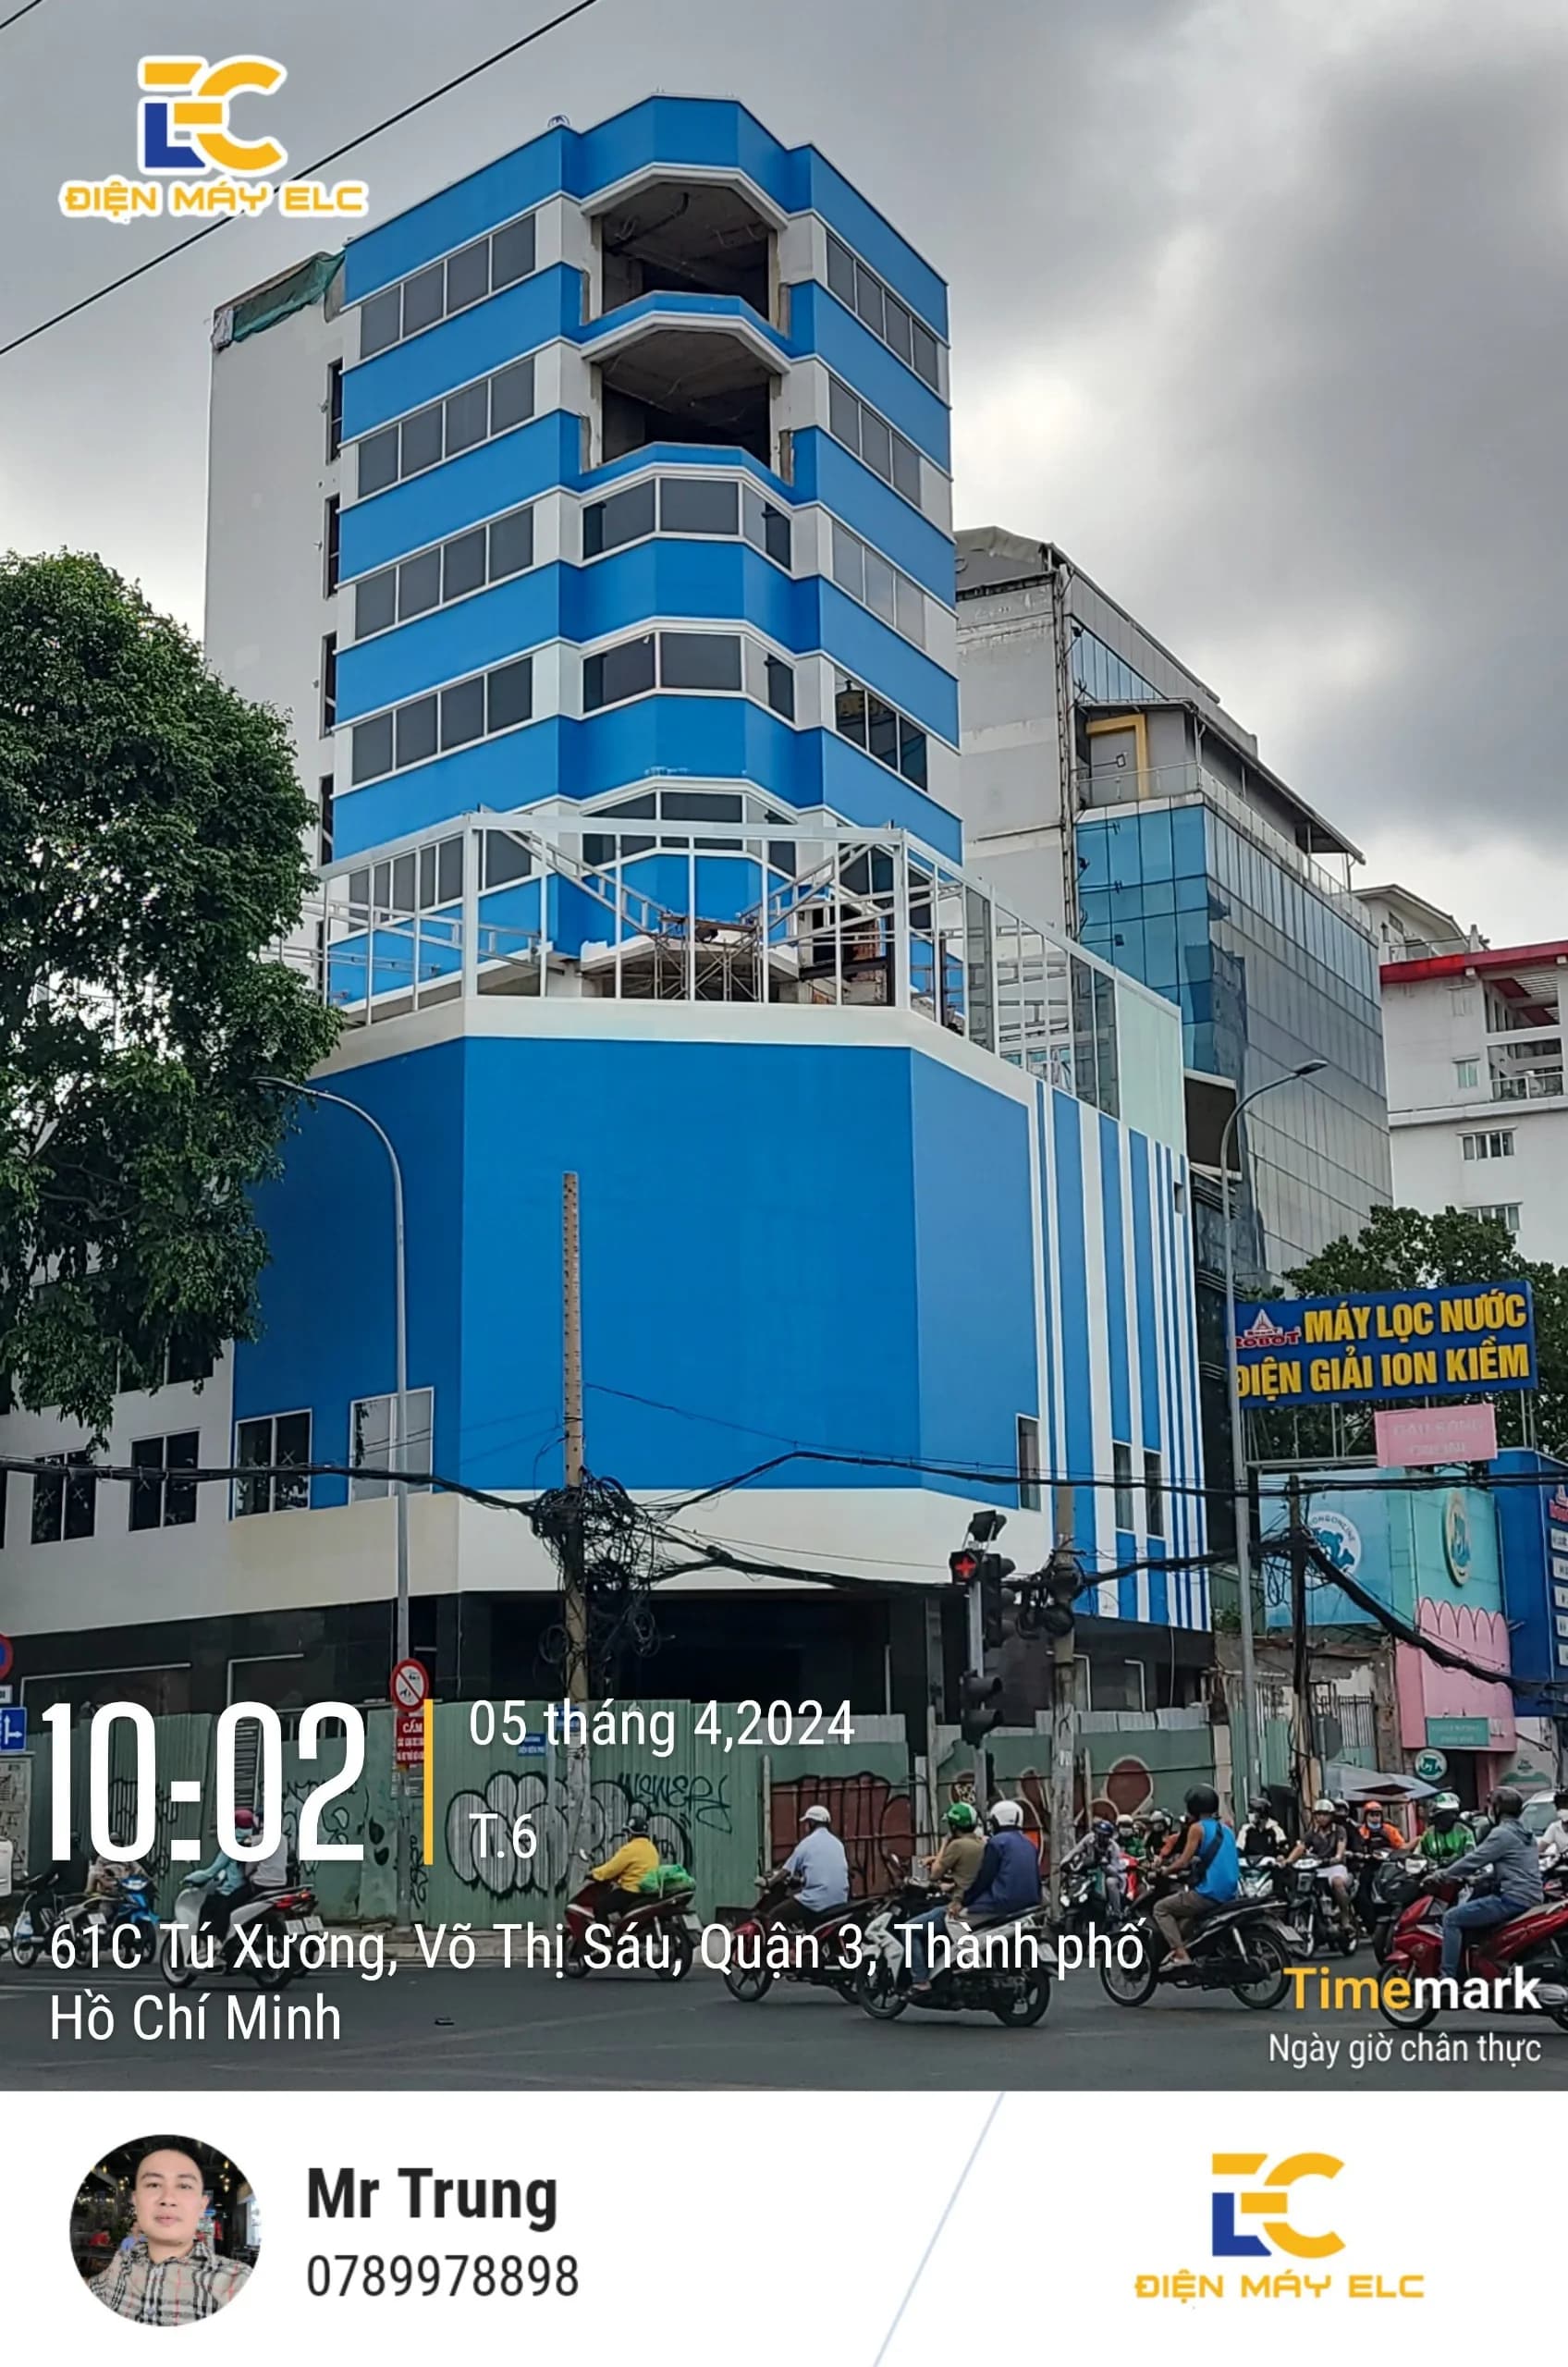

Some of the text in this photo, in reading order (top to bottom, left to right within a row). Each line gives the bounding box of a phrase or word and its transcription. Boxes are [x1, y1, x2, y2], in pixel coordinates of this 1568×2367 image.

[1305, 1289, 1526, 1343] MÁY LỌC NƯỚC
[1310, 1345, 1373, 1392] GIẢI
[1381, 1352, 1437, 1386] ION
[1447, 1335, 1530, 1382] KIỀM
